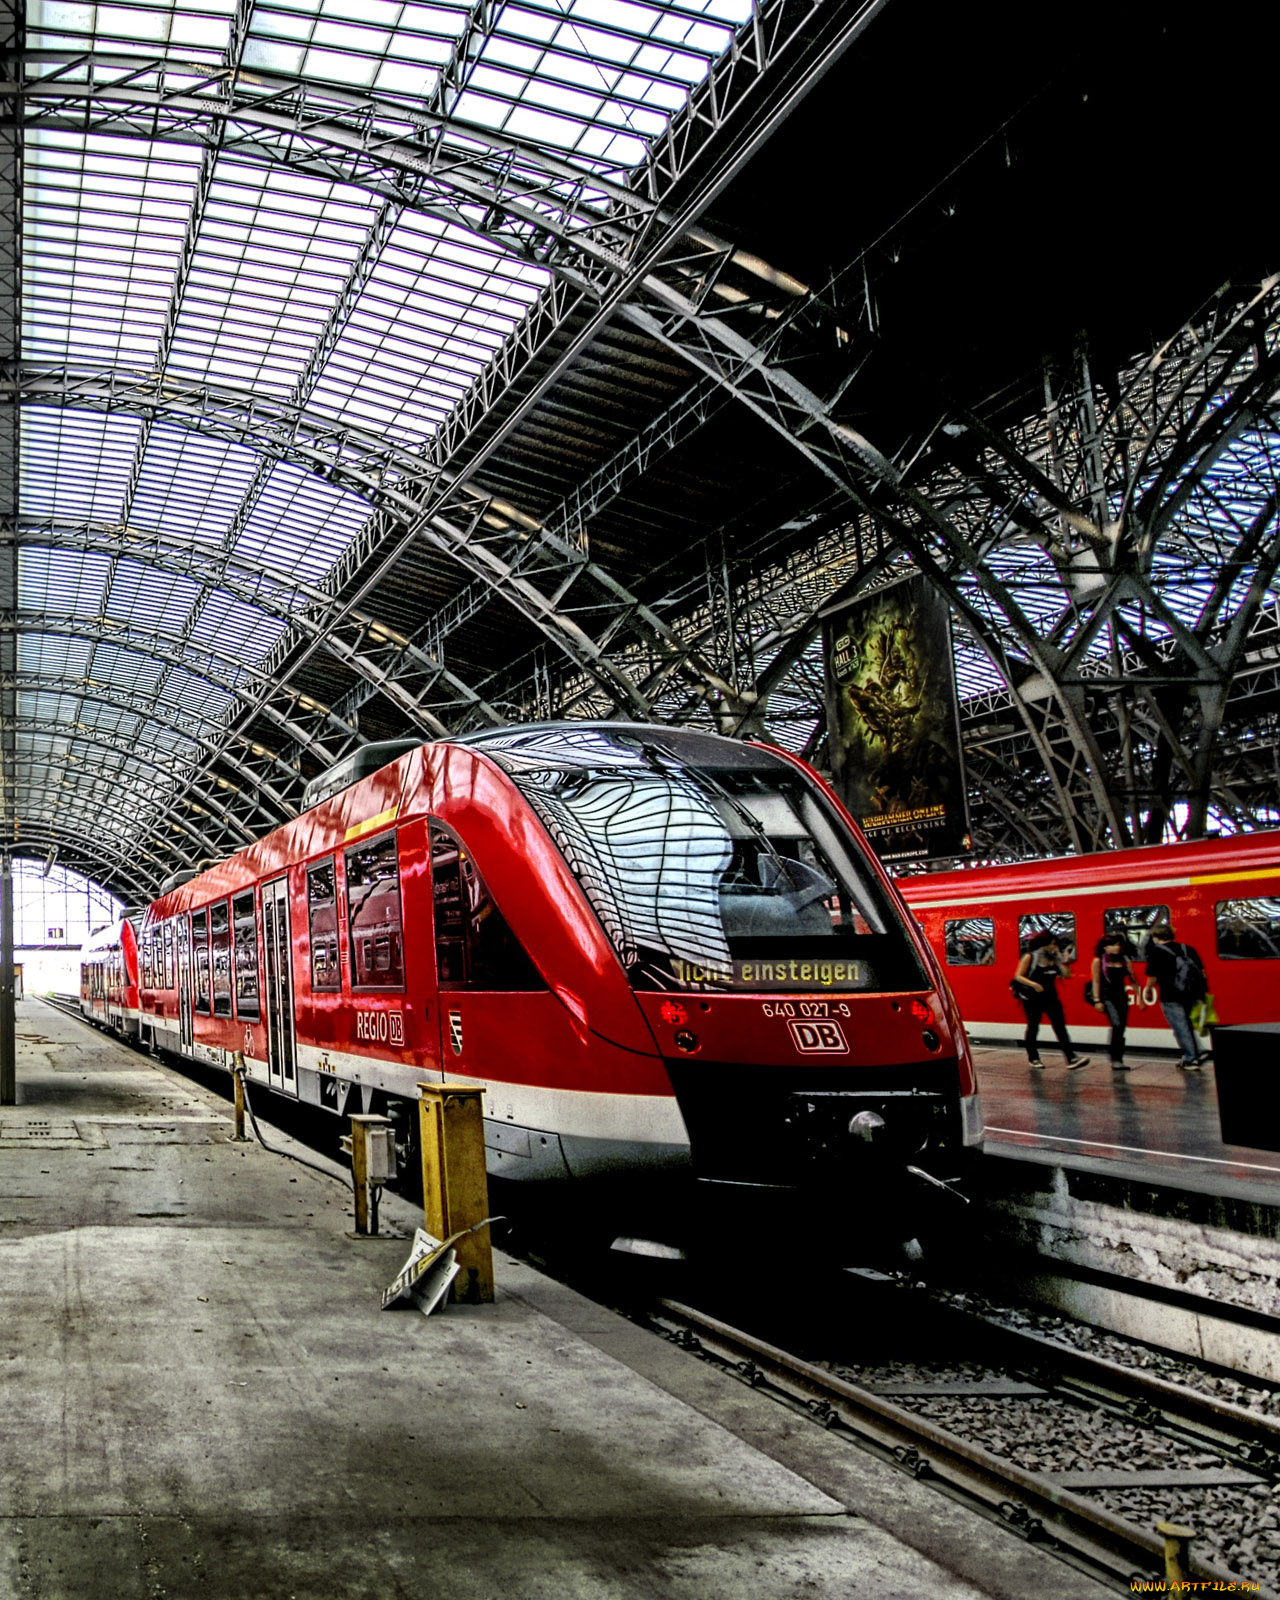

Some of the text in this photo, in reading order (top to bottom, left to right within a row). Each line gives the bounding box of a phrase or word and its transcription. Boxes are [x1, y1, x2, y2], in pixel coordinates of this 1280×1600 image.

[834, 645, 858, 669] HALL 3
[862, 804, 946, 829] WARHAMMER ONLINE
[895, 820, 946, 833] RECKONING
[741, 959, 860, 985] einsteigen
[762, 1002, 852, 1018] 640 027-9
[357, 1011, 403, 1042] REGIO DB
[793, 1021, 843, 1050] DB
